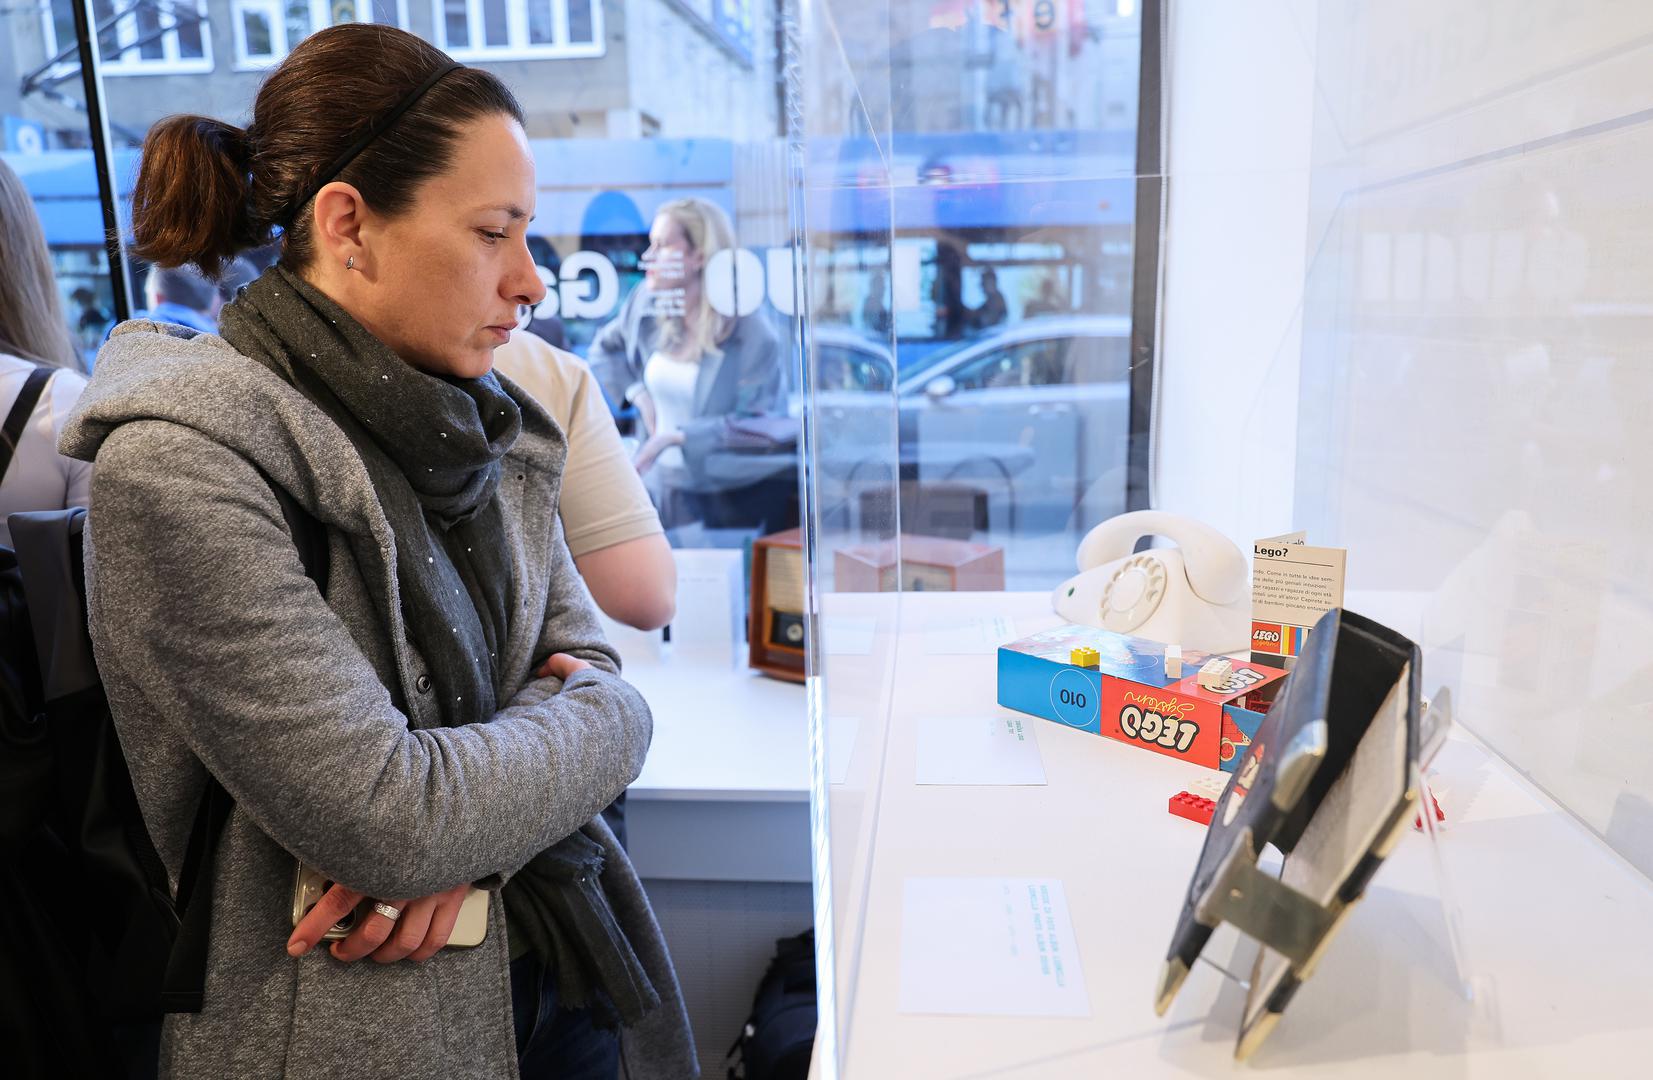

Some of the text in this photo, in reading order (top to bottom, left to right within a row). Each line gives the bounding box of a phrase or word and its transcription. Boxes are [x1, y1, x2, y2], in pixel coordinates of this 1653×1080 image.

[1254, 544, 1288, 558] Lego?
[1252, 629, 1280, 643] LEGO
[1060, 688, 1087, 709] 010
[1123, 691, 1195, 723] System
[1119, 703, 1200, 754] LEGO
